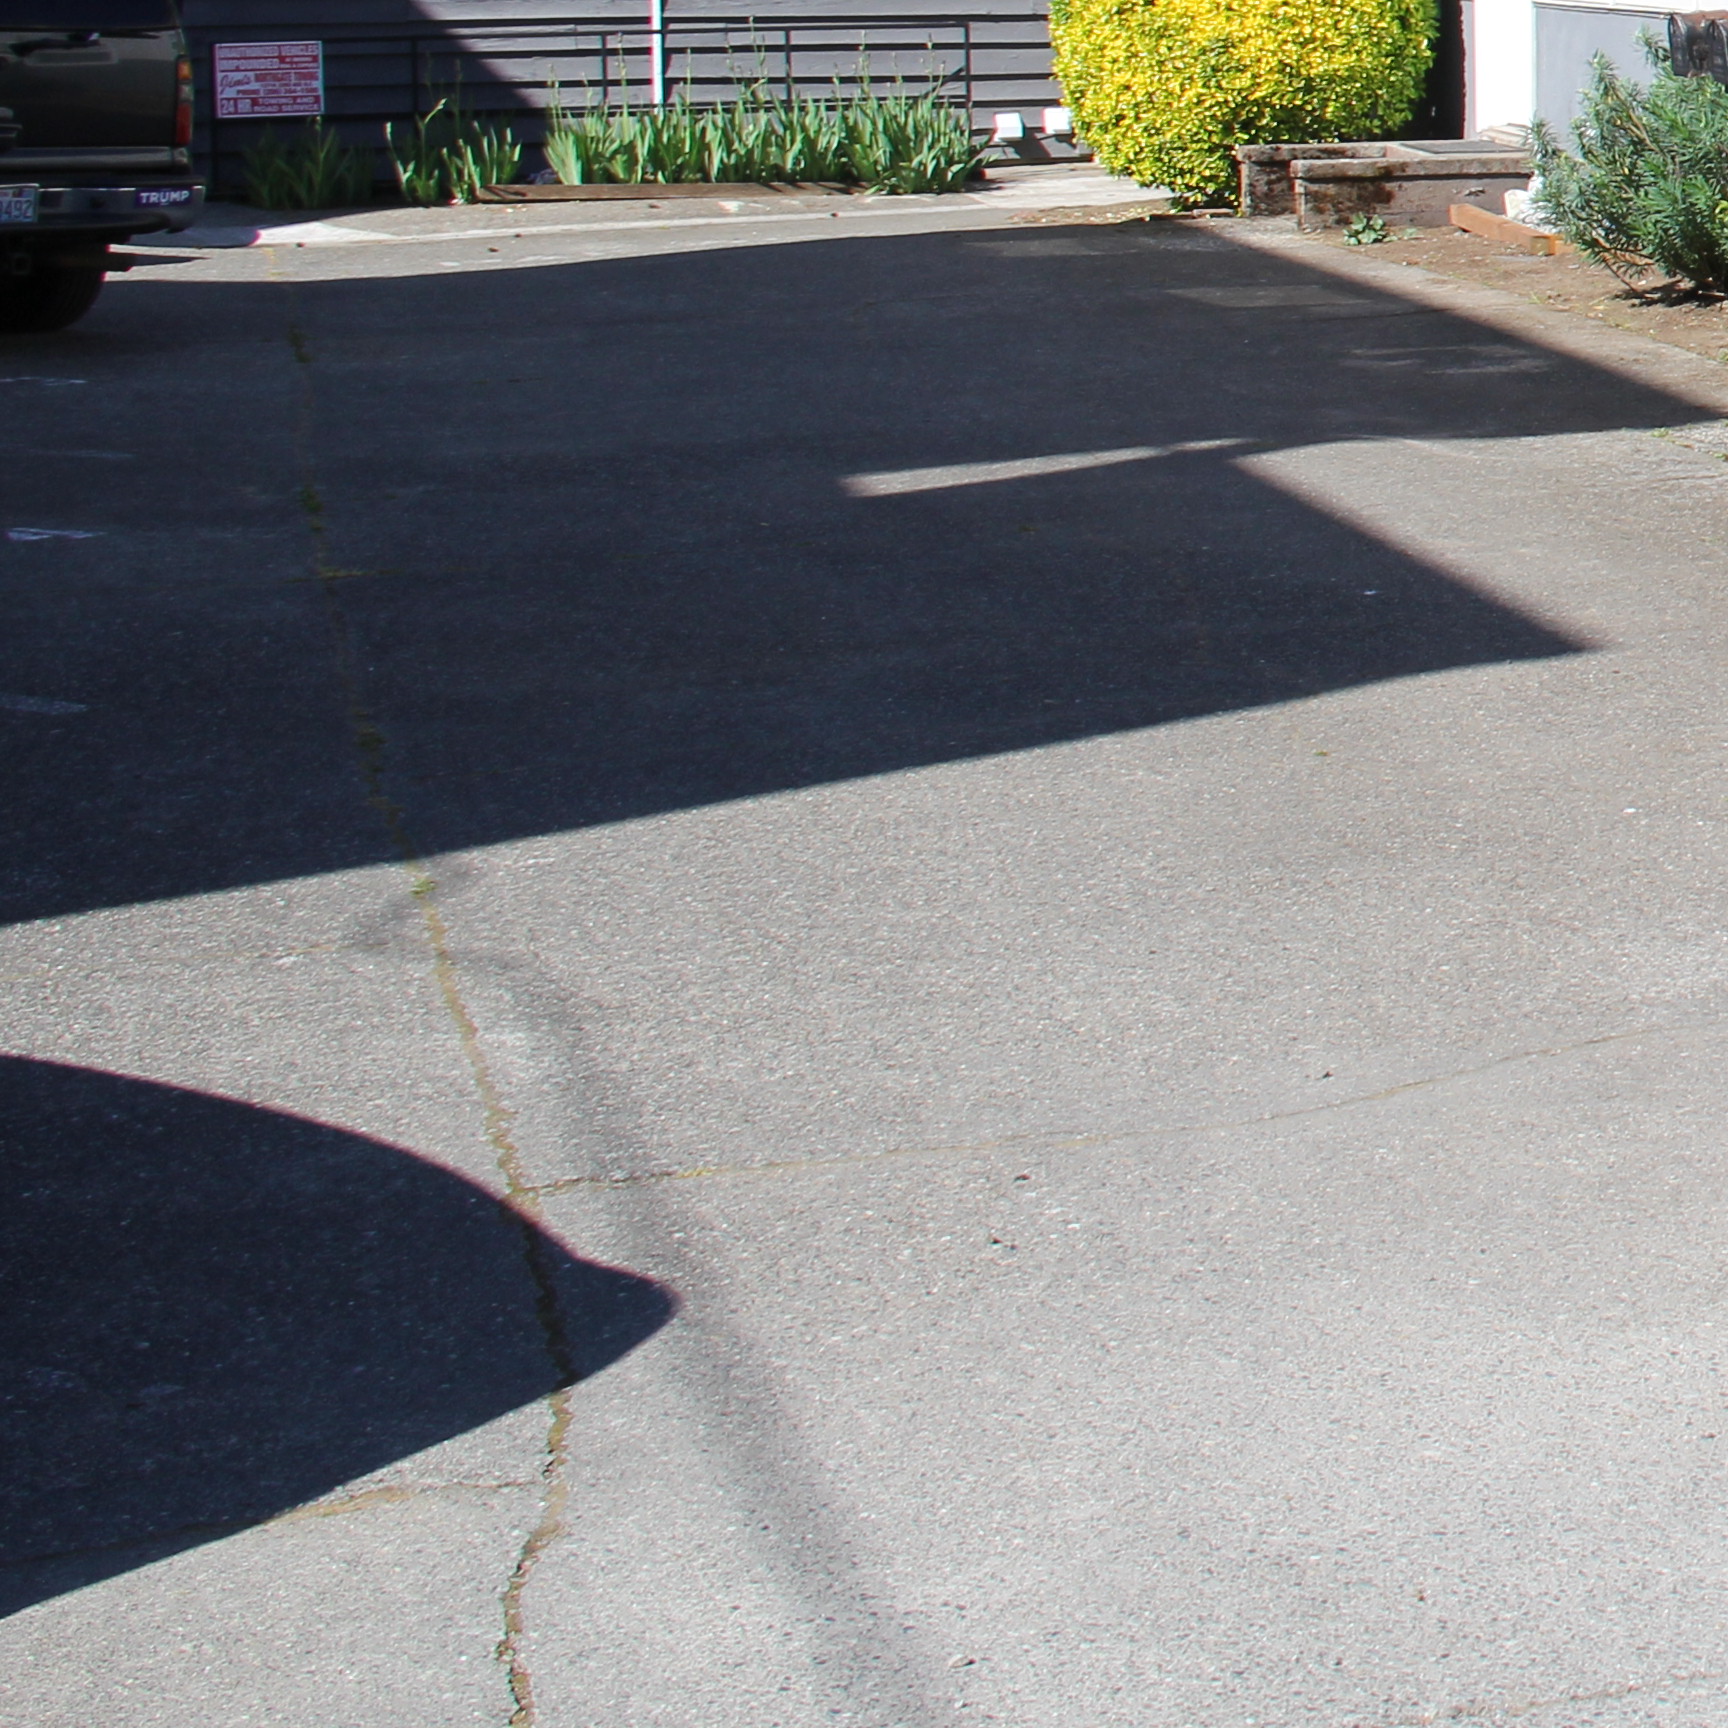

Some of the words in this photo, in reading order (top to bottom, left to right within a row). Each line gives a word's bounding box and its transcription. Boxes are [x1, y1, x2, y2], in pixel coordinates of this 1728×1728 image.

[280, 45, 319, 56] VEHICLES
[218, 58, 279, 70] IMPOUNDED
[220, 99, 235, 114] 24
[257, 97, 293, 105] TOWING
[253, 105, 280, 113] ROAD
[281, 103, 320, 112] SERVICE
[139, 191, 189, 204] TRUMP
